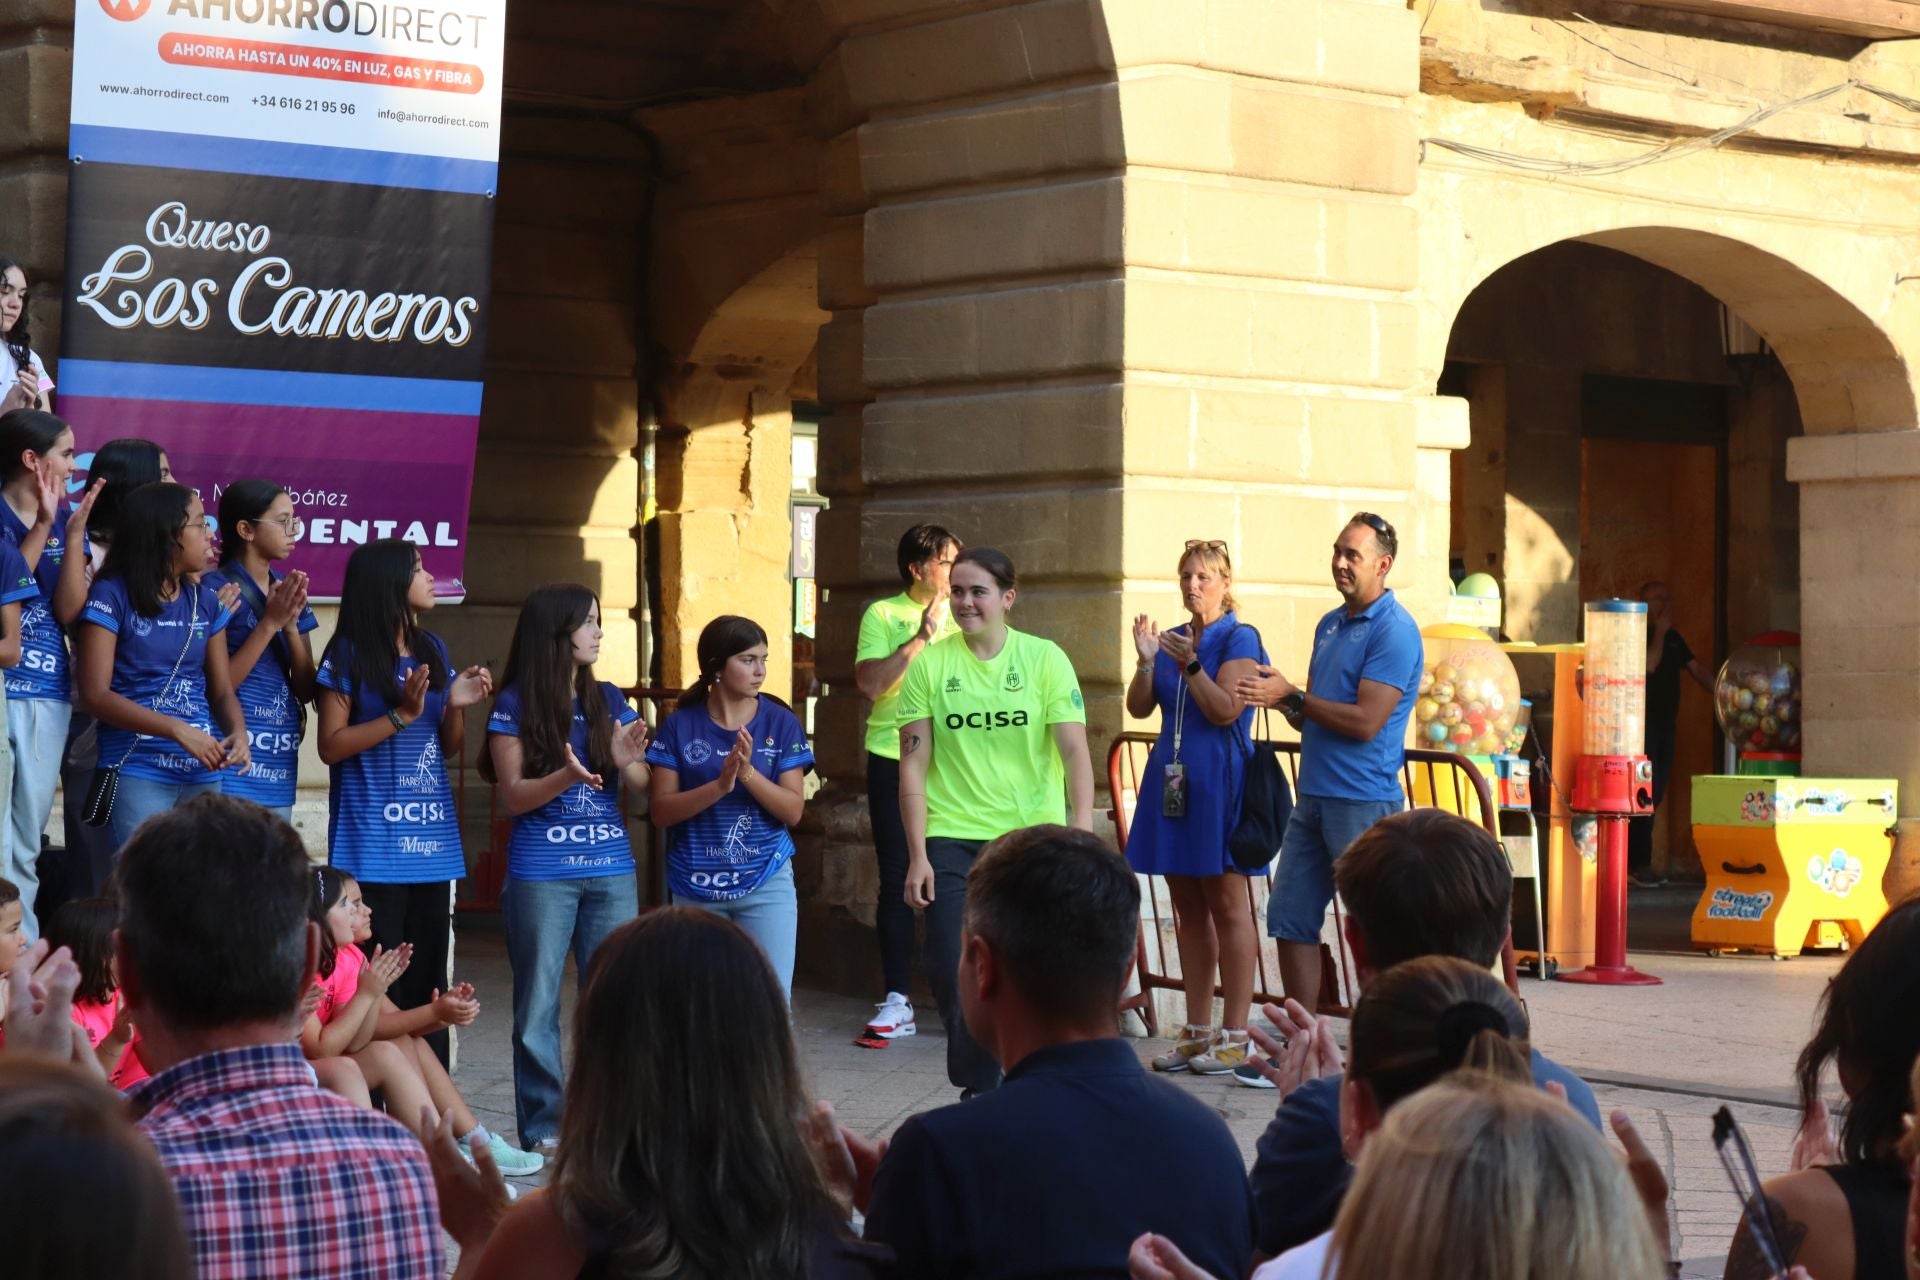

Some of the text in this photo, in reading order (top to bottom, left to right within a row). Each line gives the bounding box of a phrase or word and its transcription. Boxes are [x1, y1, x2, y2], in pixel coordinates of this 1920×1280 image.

[172, 42, 472, 86] AHORRA HASTA UN 40% EN LUZ, GAS Y FIBRA
[99, 84, 230, 104] www.ahorrodirect.com
[251, 95, 356, 116] +34 616 21 95 96
[377, 108, 489, 129] info@ahorrodirect.com
[145, 201, 271, 255] Queso
[76, 244, 479, 348] Los Cameros
[284, 485, 348, 507] báñez
[800, 511, 814, 541] GLS
[93, 600, 112, 614] Rioja
[401, 835, 439, 856] Muga
